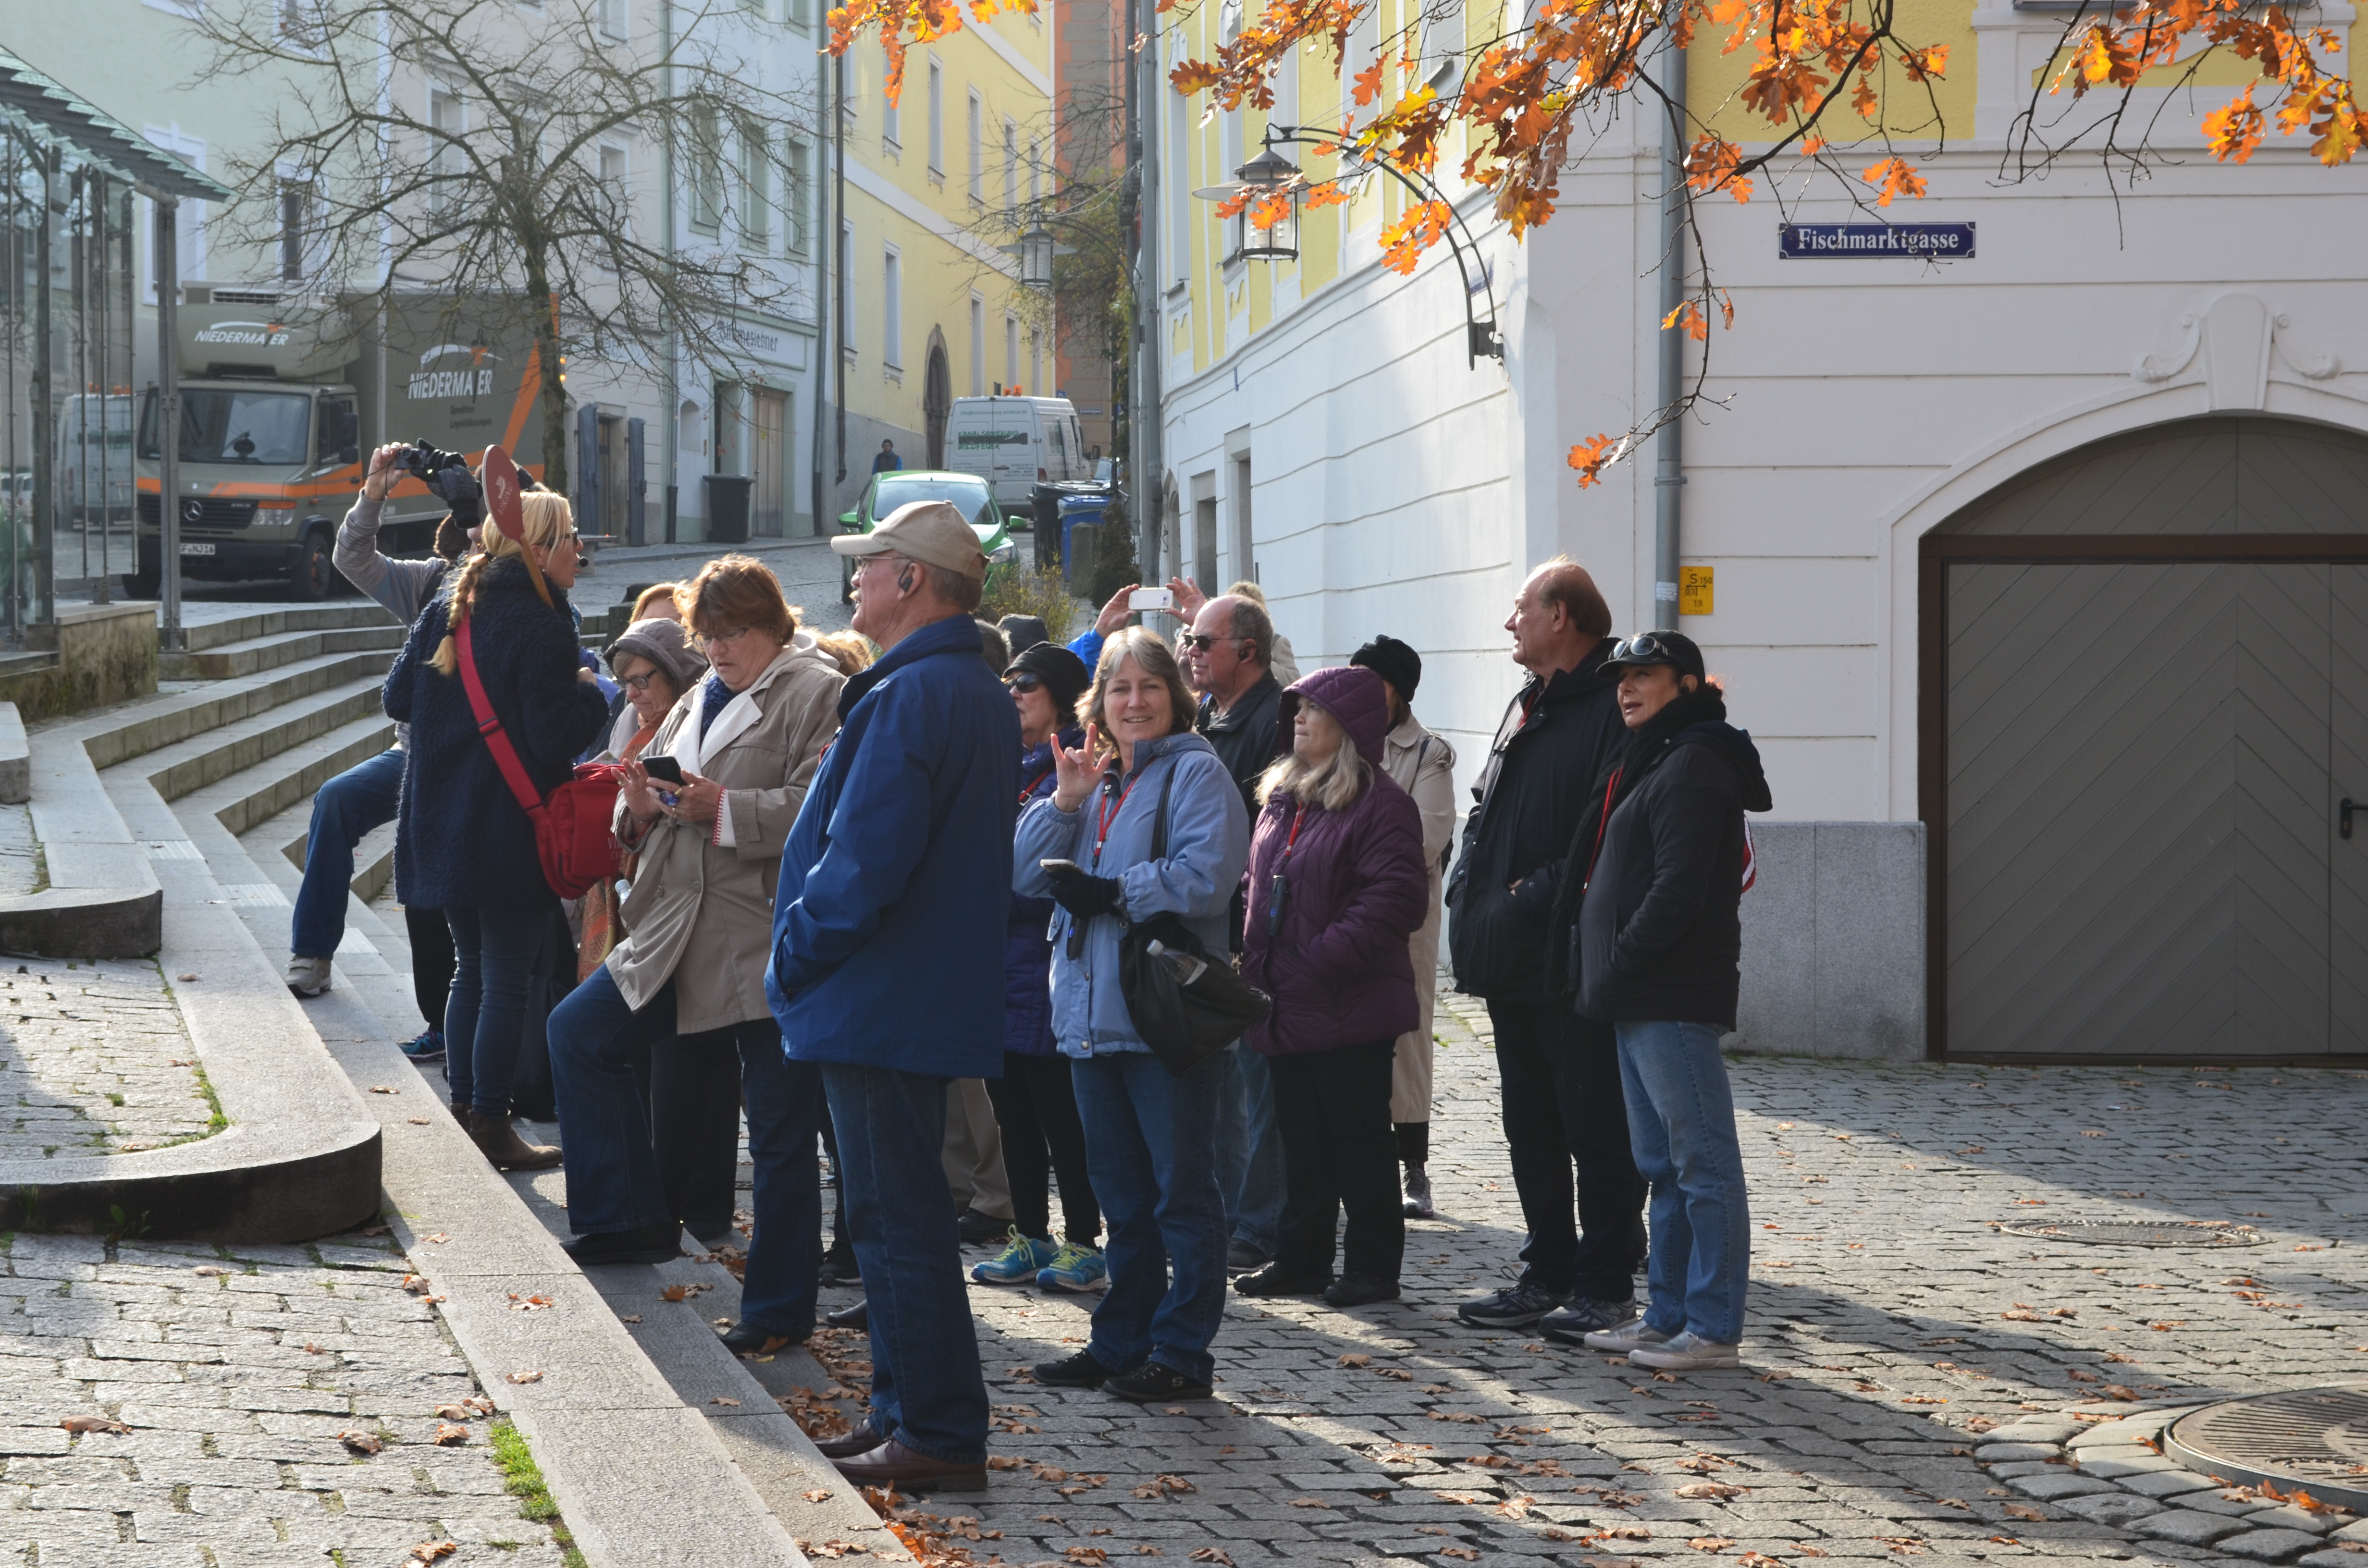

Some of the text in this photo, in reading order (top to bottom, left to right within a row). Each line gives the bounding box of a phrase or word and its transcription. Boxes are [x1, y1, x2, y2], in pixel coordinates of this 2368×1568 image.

[1797, 228, 1959, 254] Fischmarktgasse
[497, 481, 514, 515] VIKING
[1690, 574, 1697, 584] S
